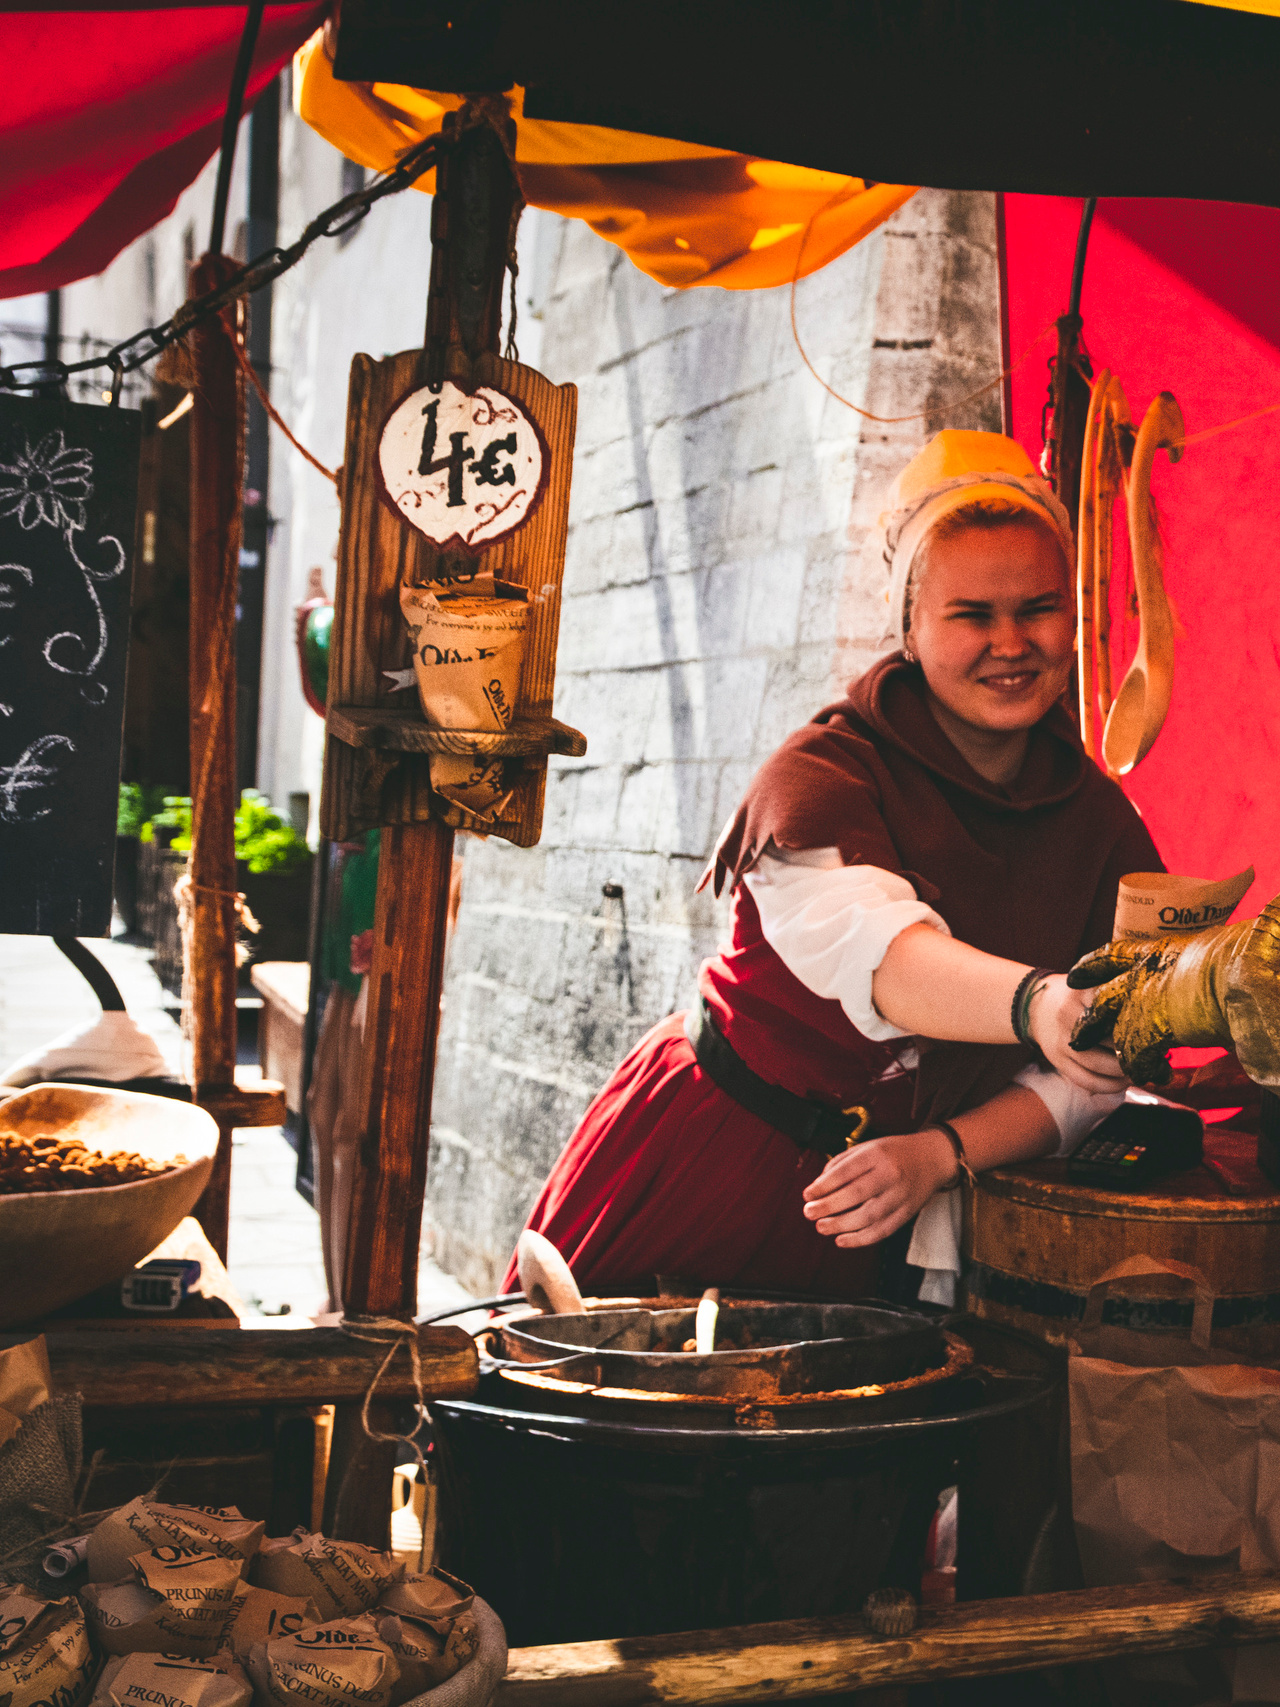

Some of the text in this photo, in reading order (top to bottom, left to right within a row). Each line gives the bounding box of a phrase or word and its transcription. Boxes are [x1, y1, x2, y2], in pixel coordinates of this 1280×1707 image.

[1157, 905, 1200, 925] Olde
[166, 1588, 223, 1602] PRUNUS
[217, 1594, 247, 1649] PRUNUS
[12, 1669, 32, 1685] For
